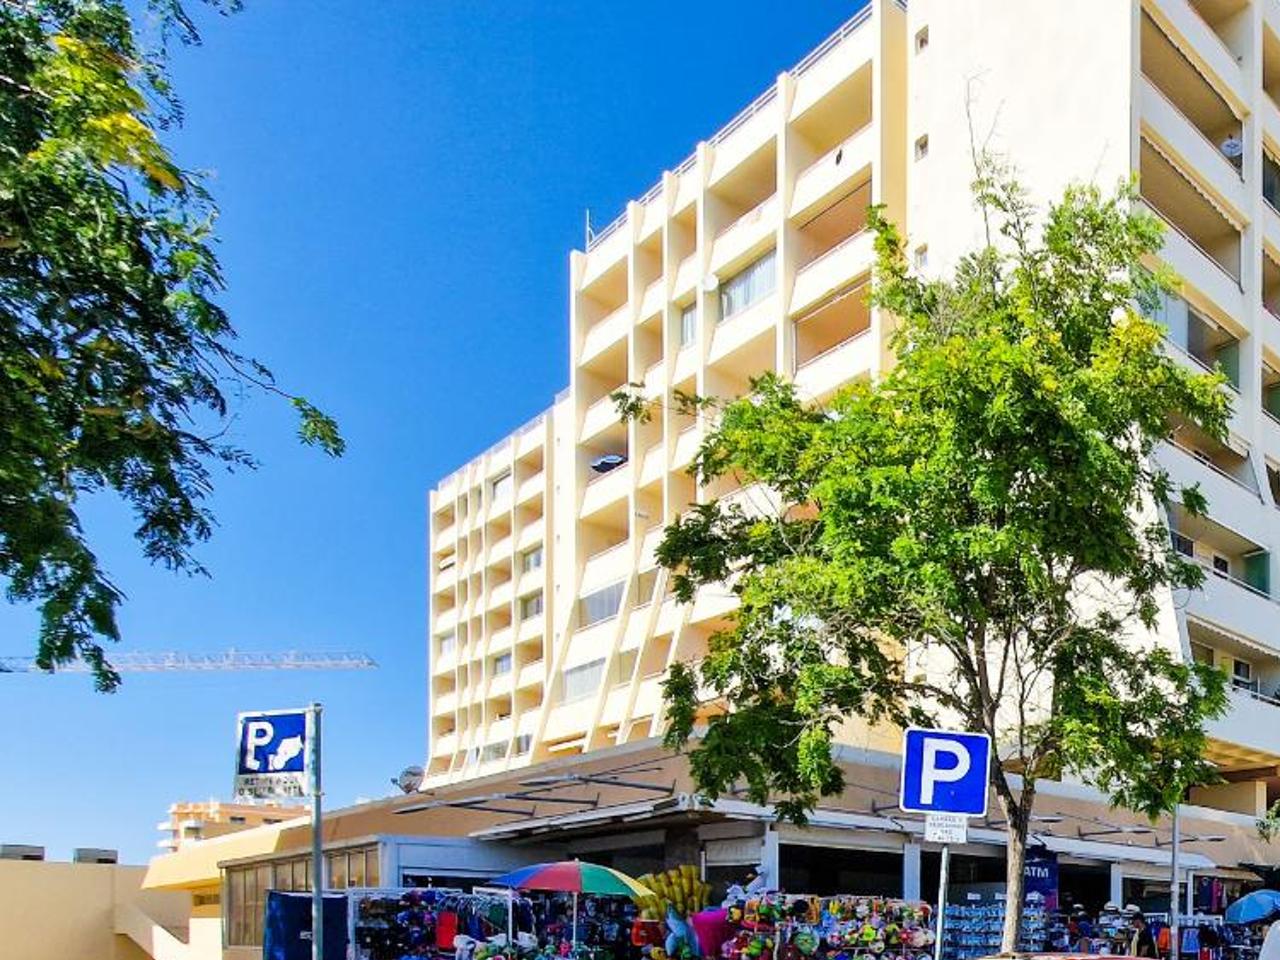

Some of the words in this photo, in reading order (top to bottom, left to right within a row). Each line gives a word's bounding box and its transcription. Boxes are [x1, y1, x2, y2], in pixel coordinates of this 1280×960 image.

[246, 721, 274, 770] P
[920, 737, 970, 805] P
[1024, 866, 1049, 878] ATM
